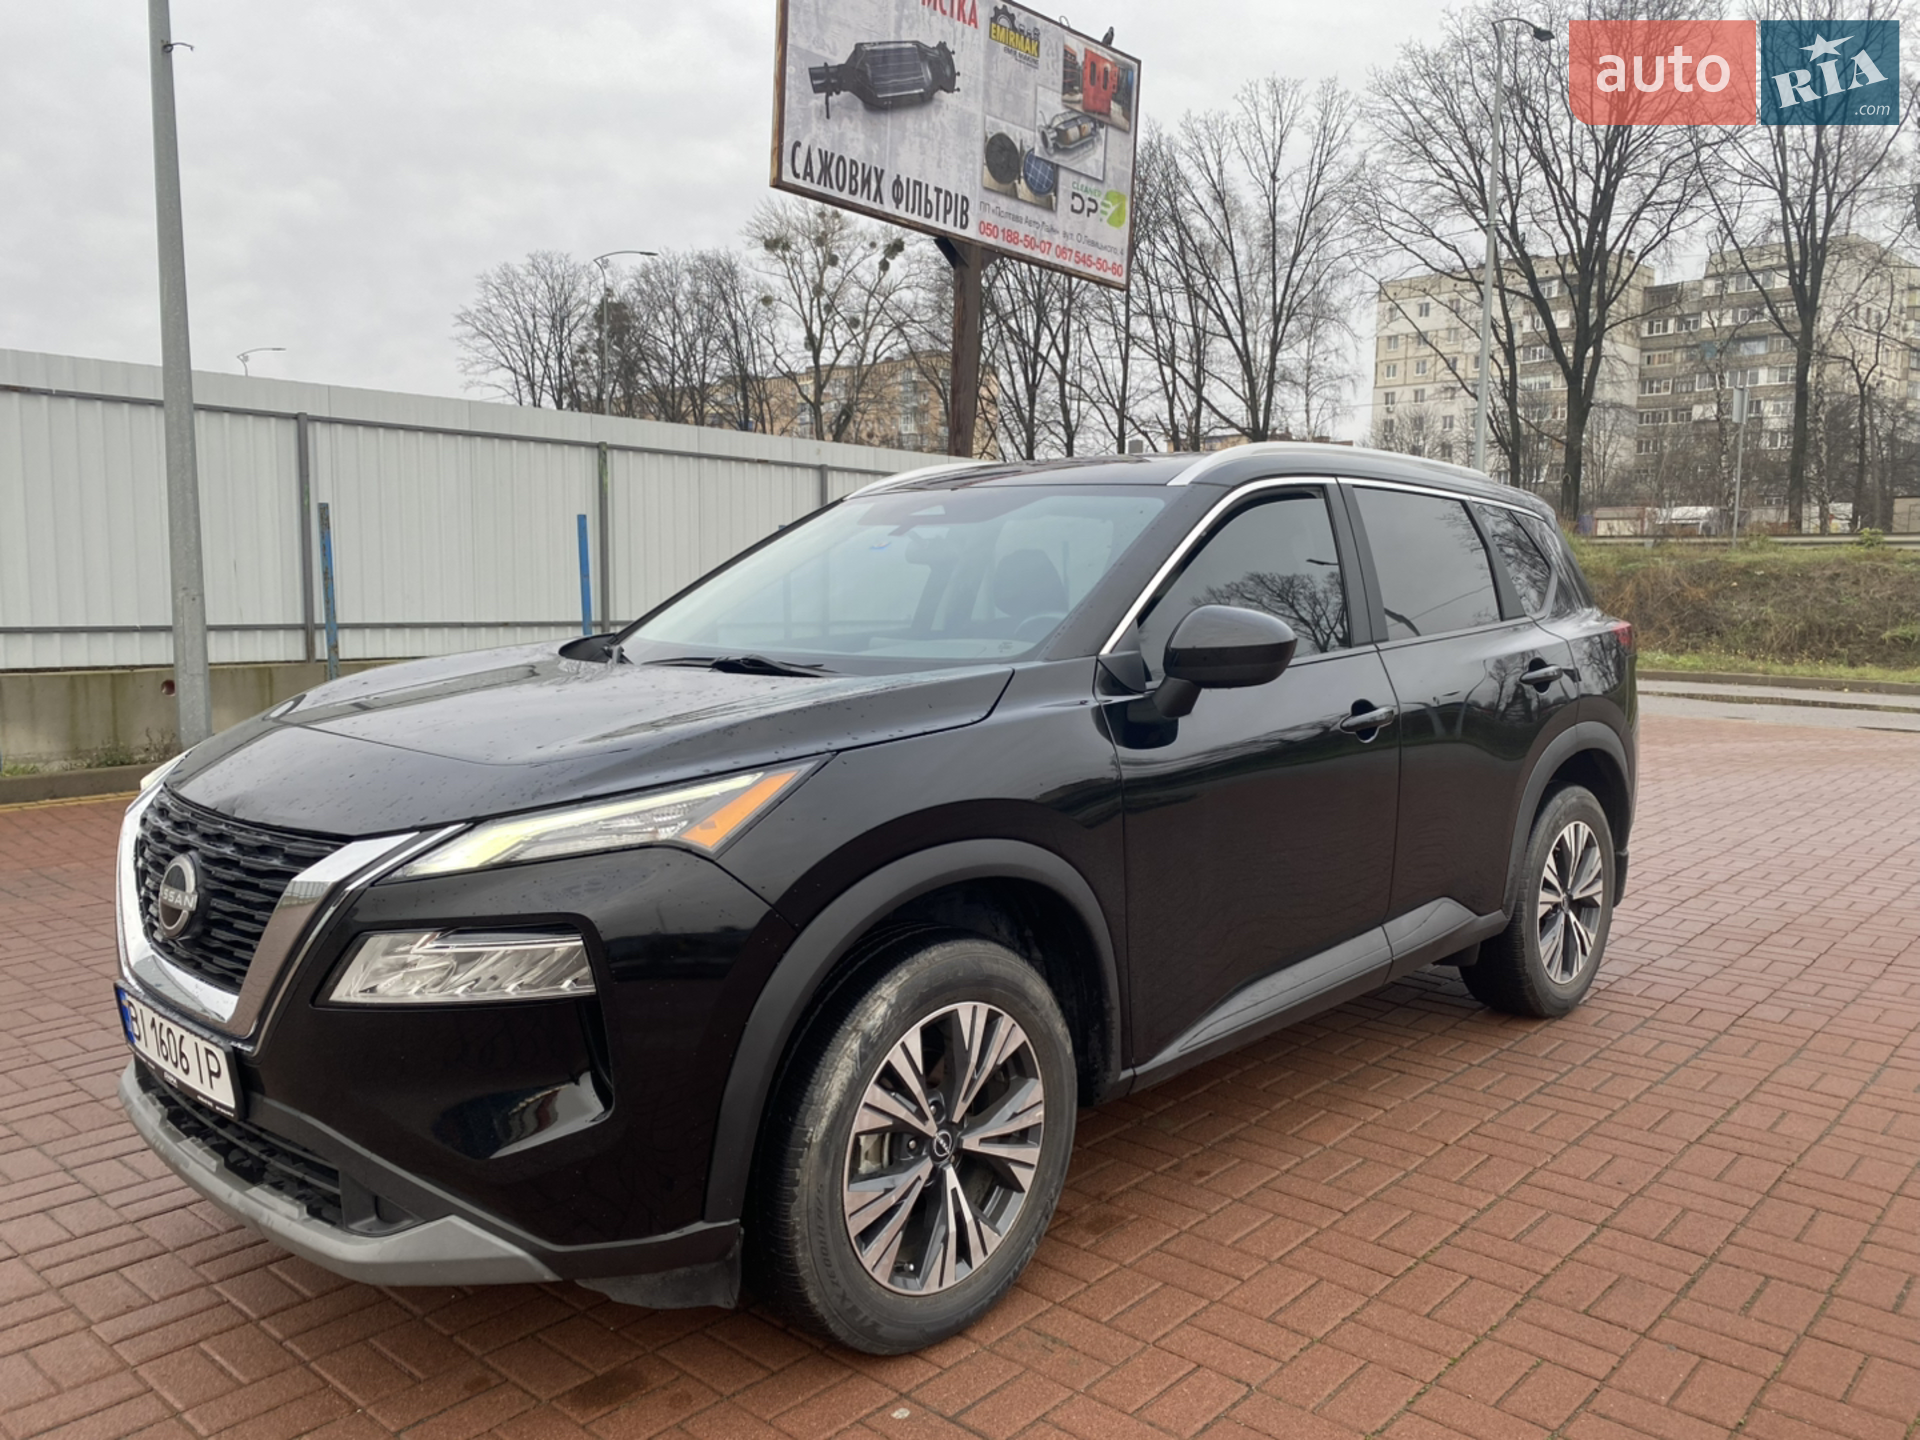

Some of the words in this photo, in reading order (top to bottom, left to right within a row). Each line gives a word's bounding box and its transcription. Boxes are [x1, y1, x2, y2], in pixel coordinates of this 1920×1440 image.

[990, 22, 1039, 58] EMIRMAK
[791, 140, 885, 205] САЖОВИХ
[891, 174, 970, 230] ФІЛЬТРІВ
[979, 220, 1000, 239] 050
[1001, 227, 1052, 255] 188-50-07
[1056, 244, 1073, 262] 067
[1074, 251, 1123, 277] 545-50-60
[151, 1016, 190, 1076] 1606
[194, 1041, 222, 1091] IP
